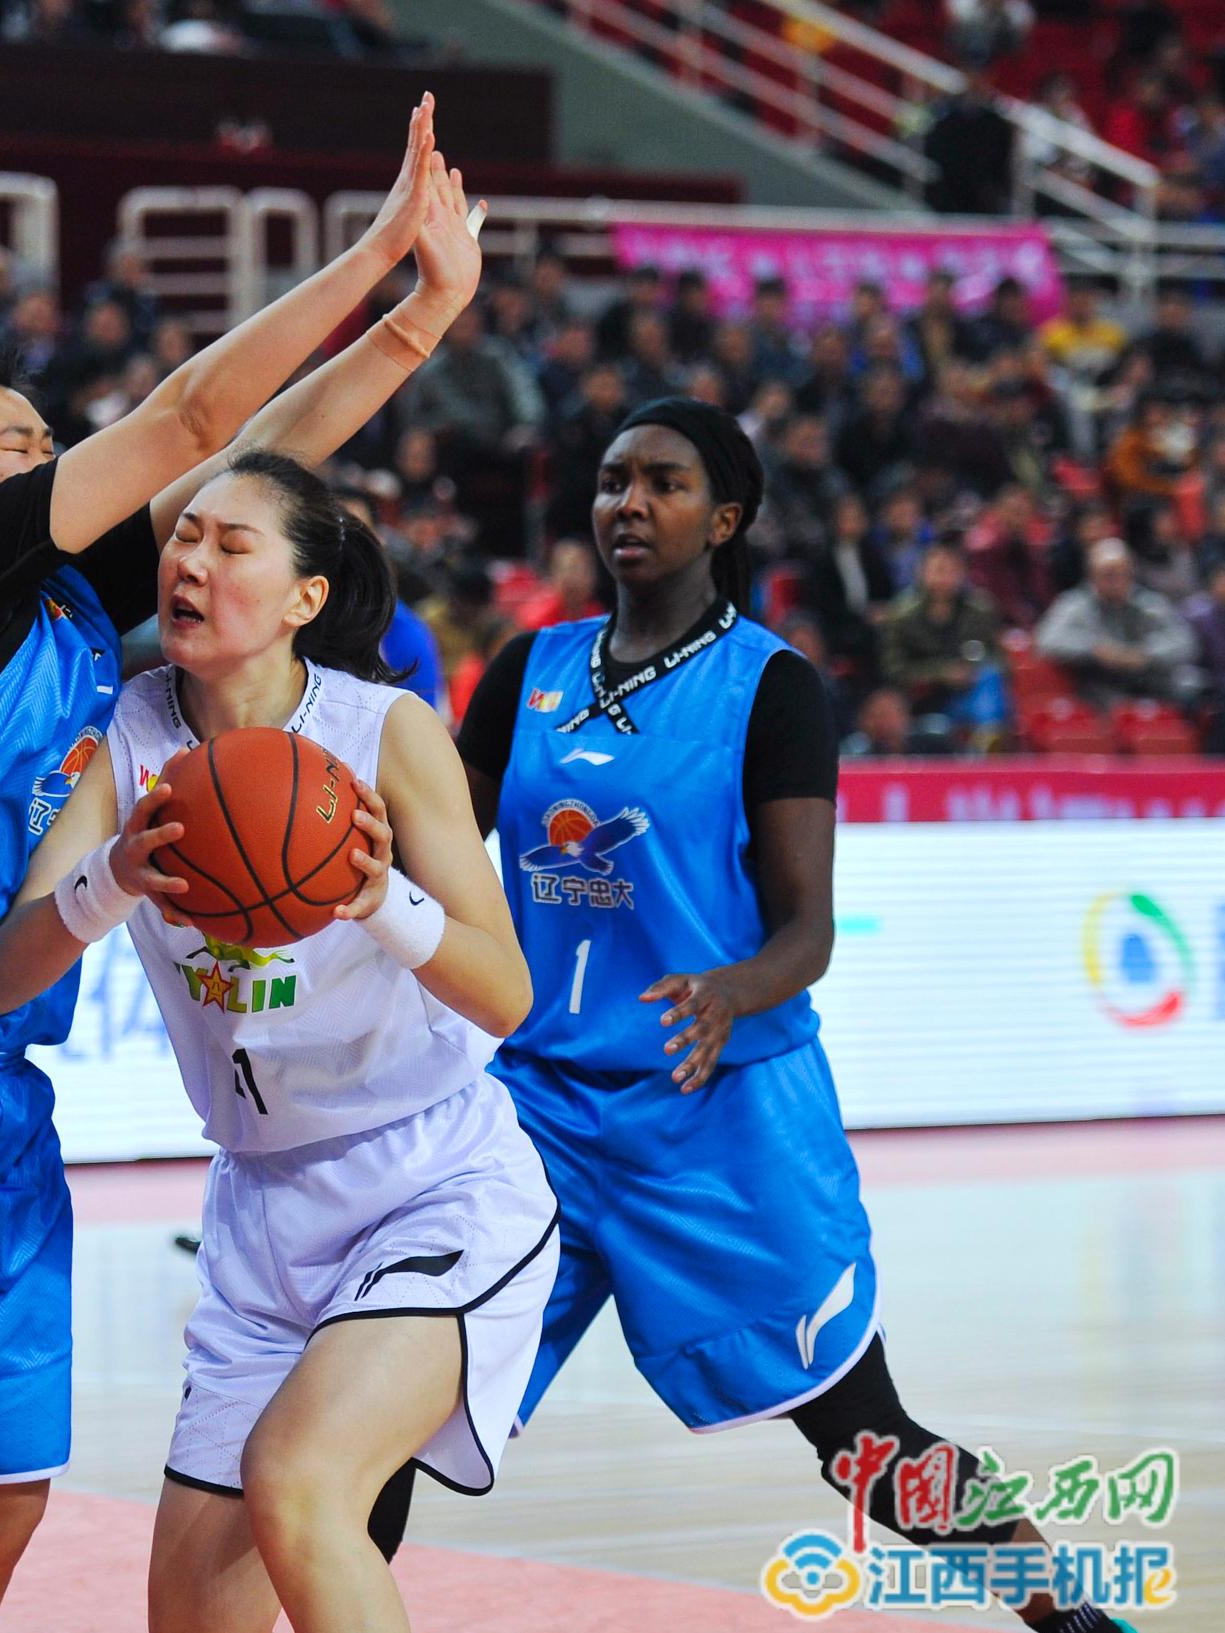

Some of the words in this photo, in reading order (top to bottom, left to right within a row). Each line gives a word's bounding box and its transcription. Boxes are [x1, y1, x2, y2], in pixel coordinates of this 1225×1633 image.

[664, 630, 717, 669] LI-NING
[291, 674, 322, 734] LI-NING
[599, 665, 657, 709] LI-NING
[531, 872, 635, 910] 辽宁忠大
[174, 962, 297, 1014] YLIN
[569, 940, 591, 1014] 1
